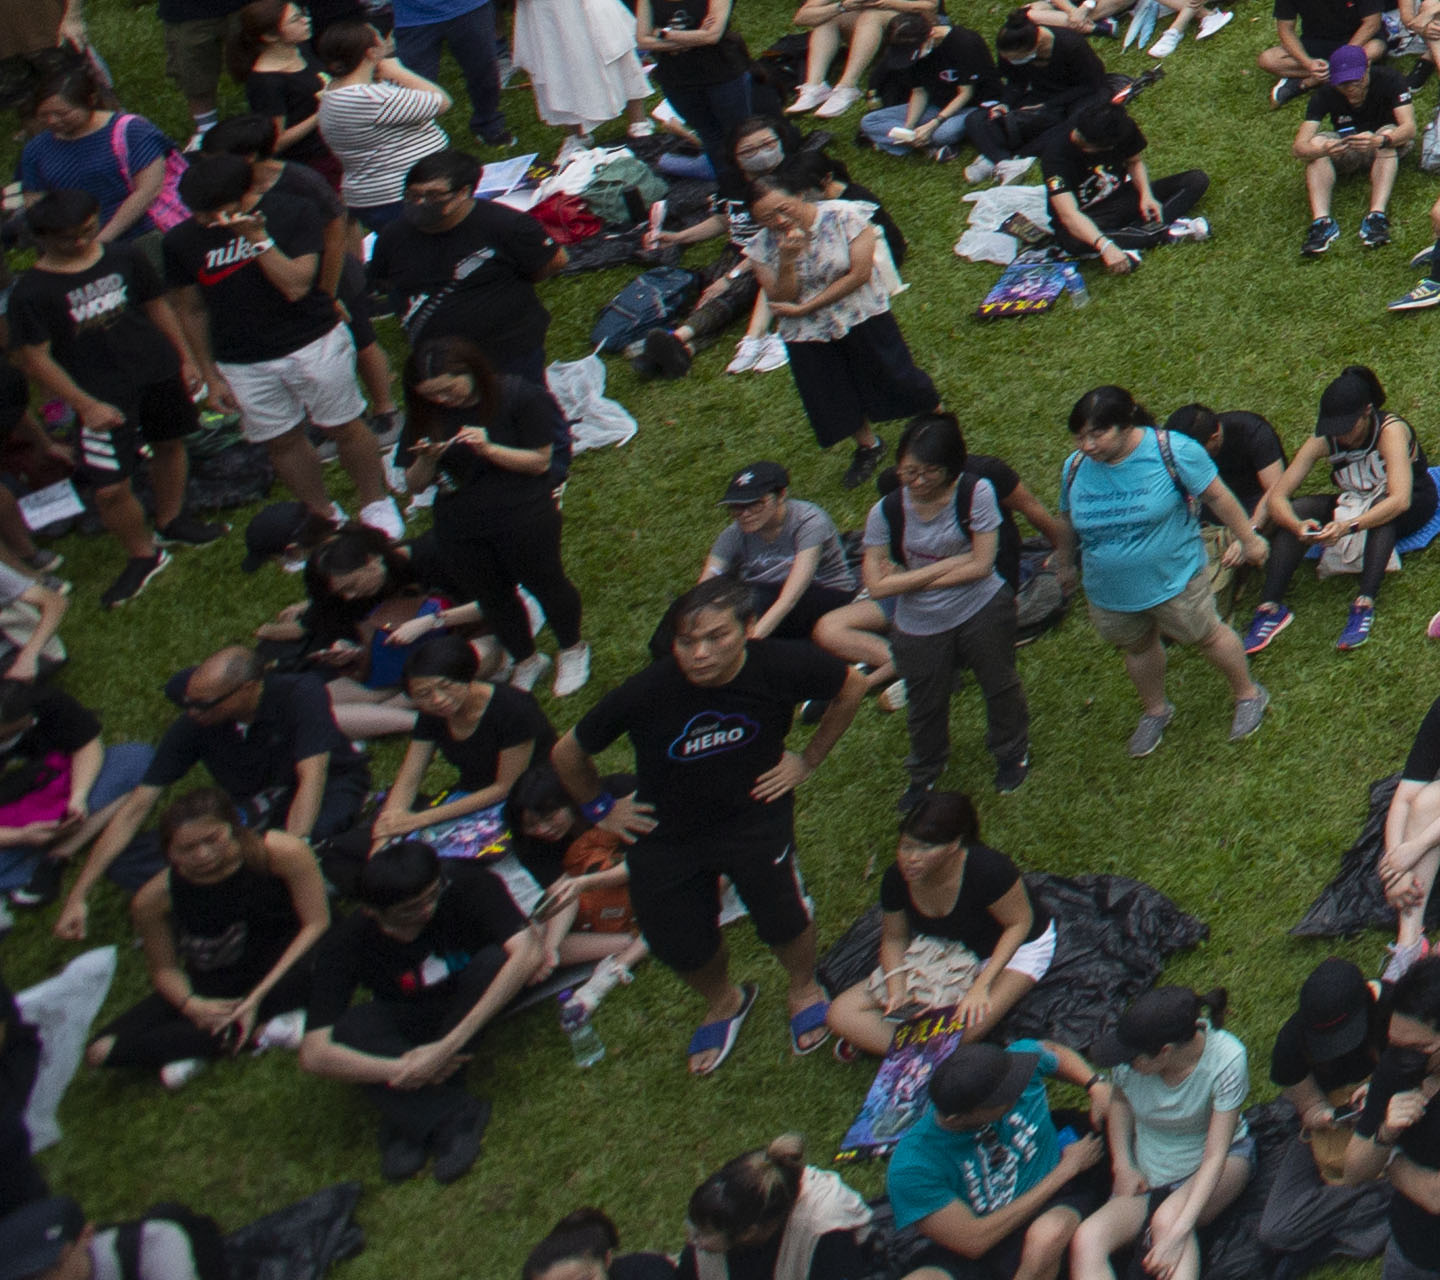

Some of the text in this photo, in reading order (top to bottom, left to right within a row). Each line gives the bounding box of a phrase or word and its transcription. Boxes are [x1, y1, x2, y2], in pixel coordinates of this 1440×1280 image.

[66, 272, 125, 302] HARD
[69, 285, 129, 323] WORK
[683, 726, 745, 757] HERO
